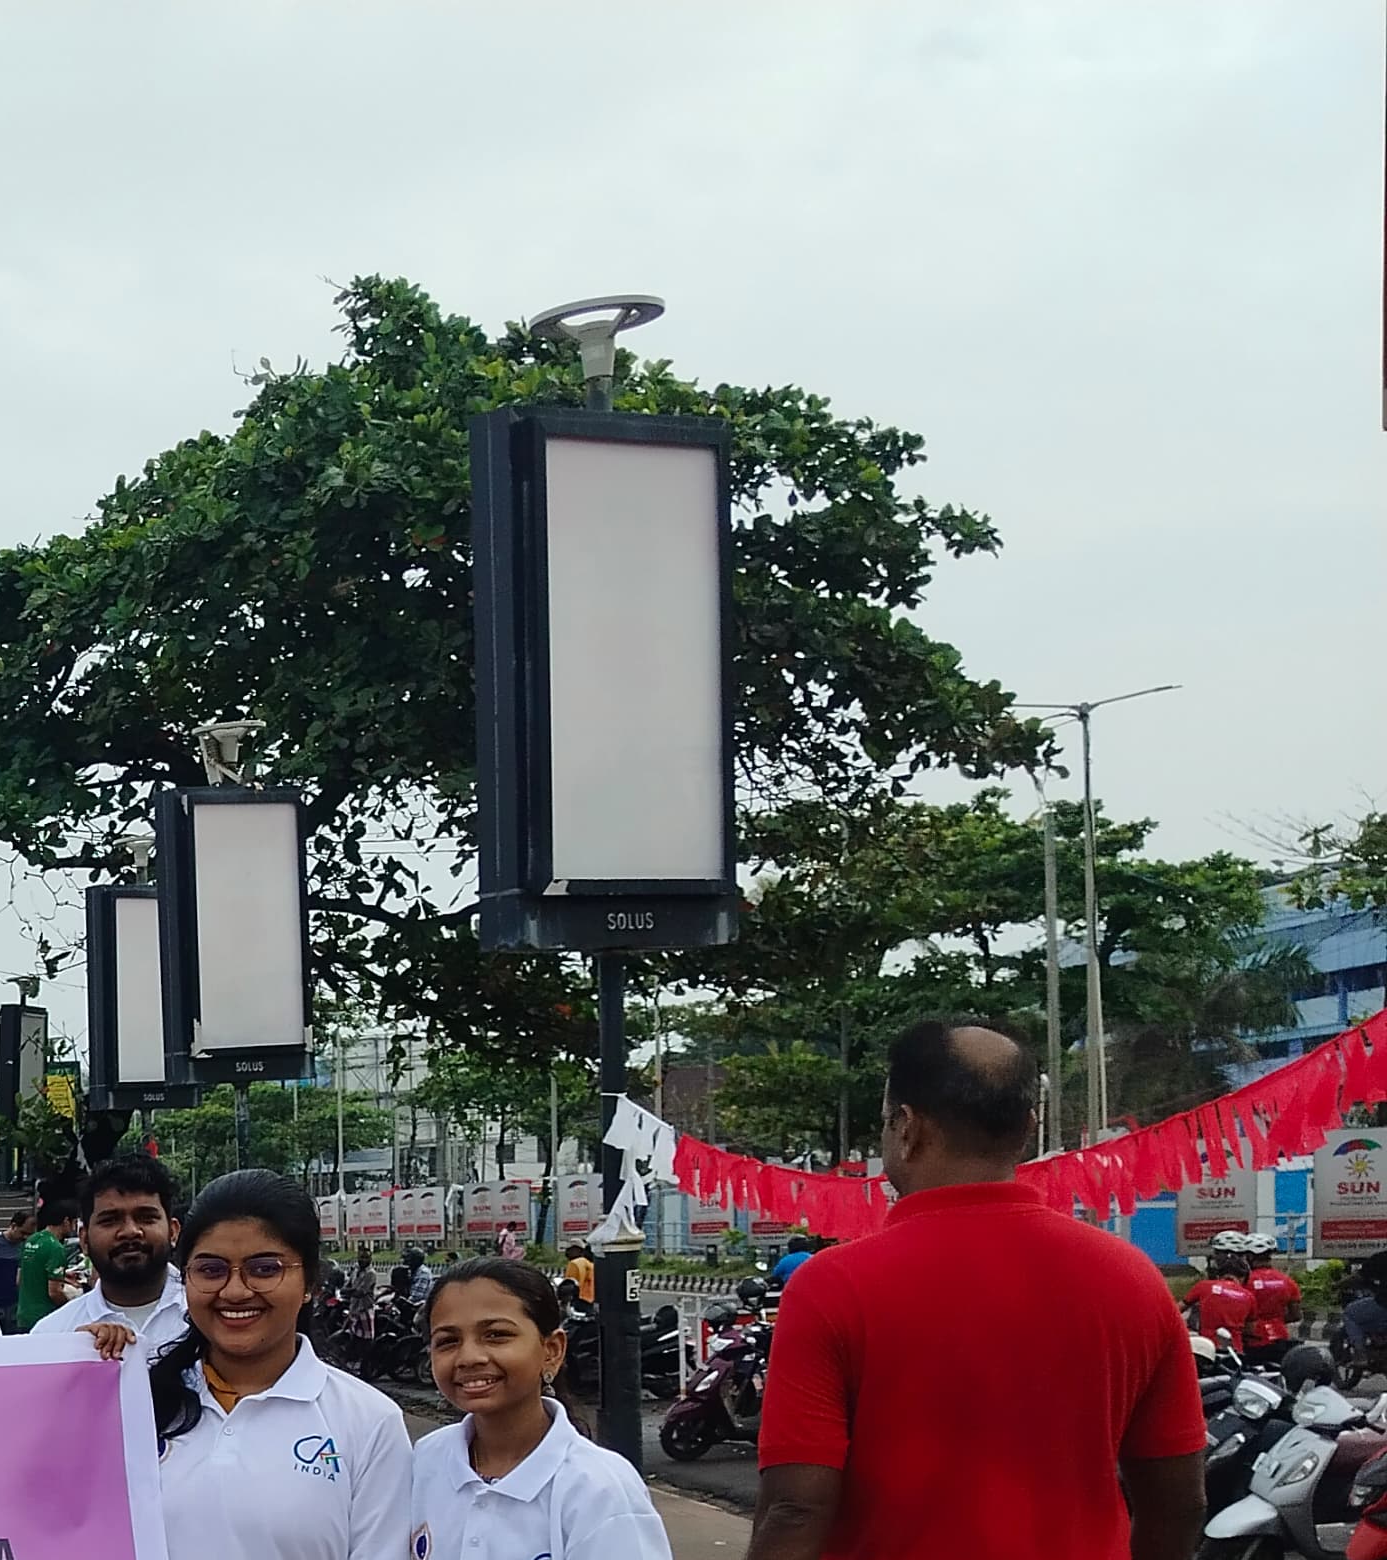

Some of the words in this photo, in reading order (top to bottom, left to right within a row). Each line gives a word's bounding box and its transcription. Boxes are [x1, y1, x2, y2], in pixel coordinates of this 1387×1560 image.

[607, 912, 654, 929] SOLUS
[235, 1062, 264, 1072] SOLUS
[1196, 1187, 1236, 1199] SUN
[1337, 1181, 1381, 1195] SUN
[294, 1463, 336, 1482] INDIA
